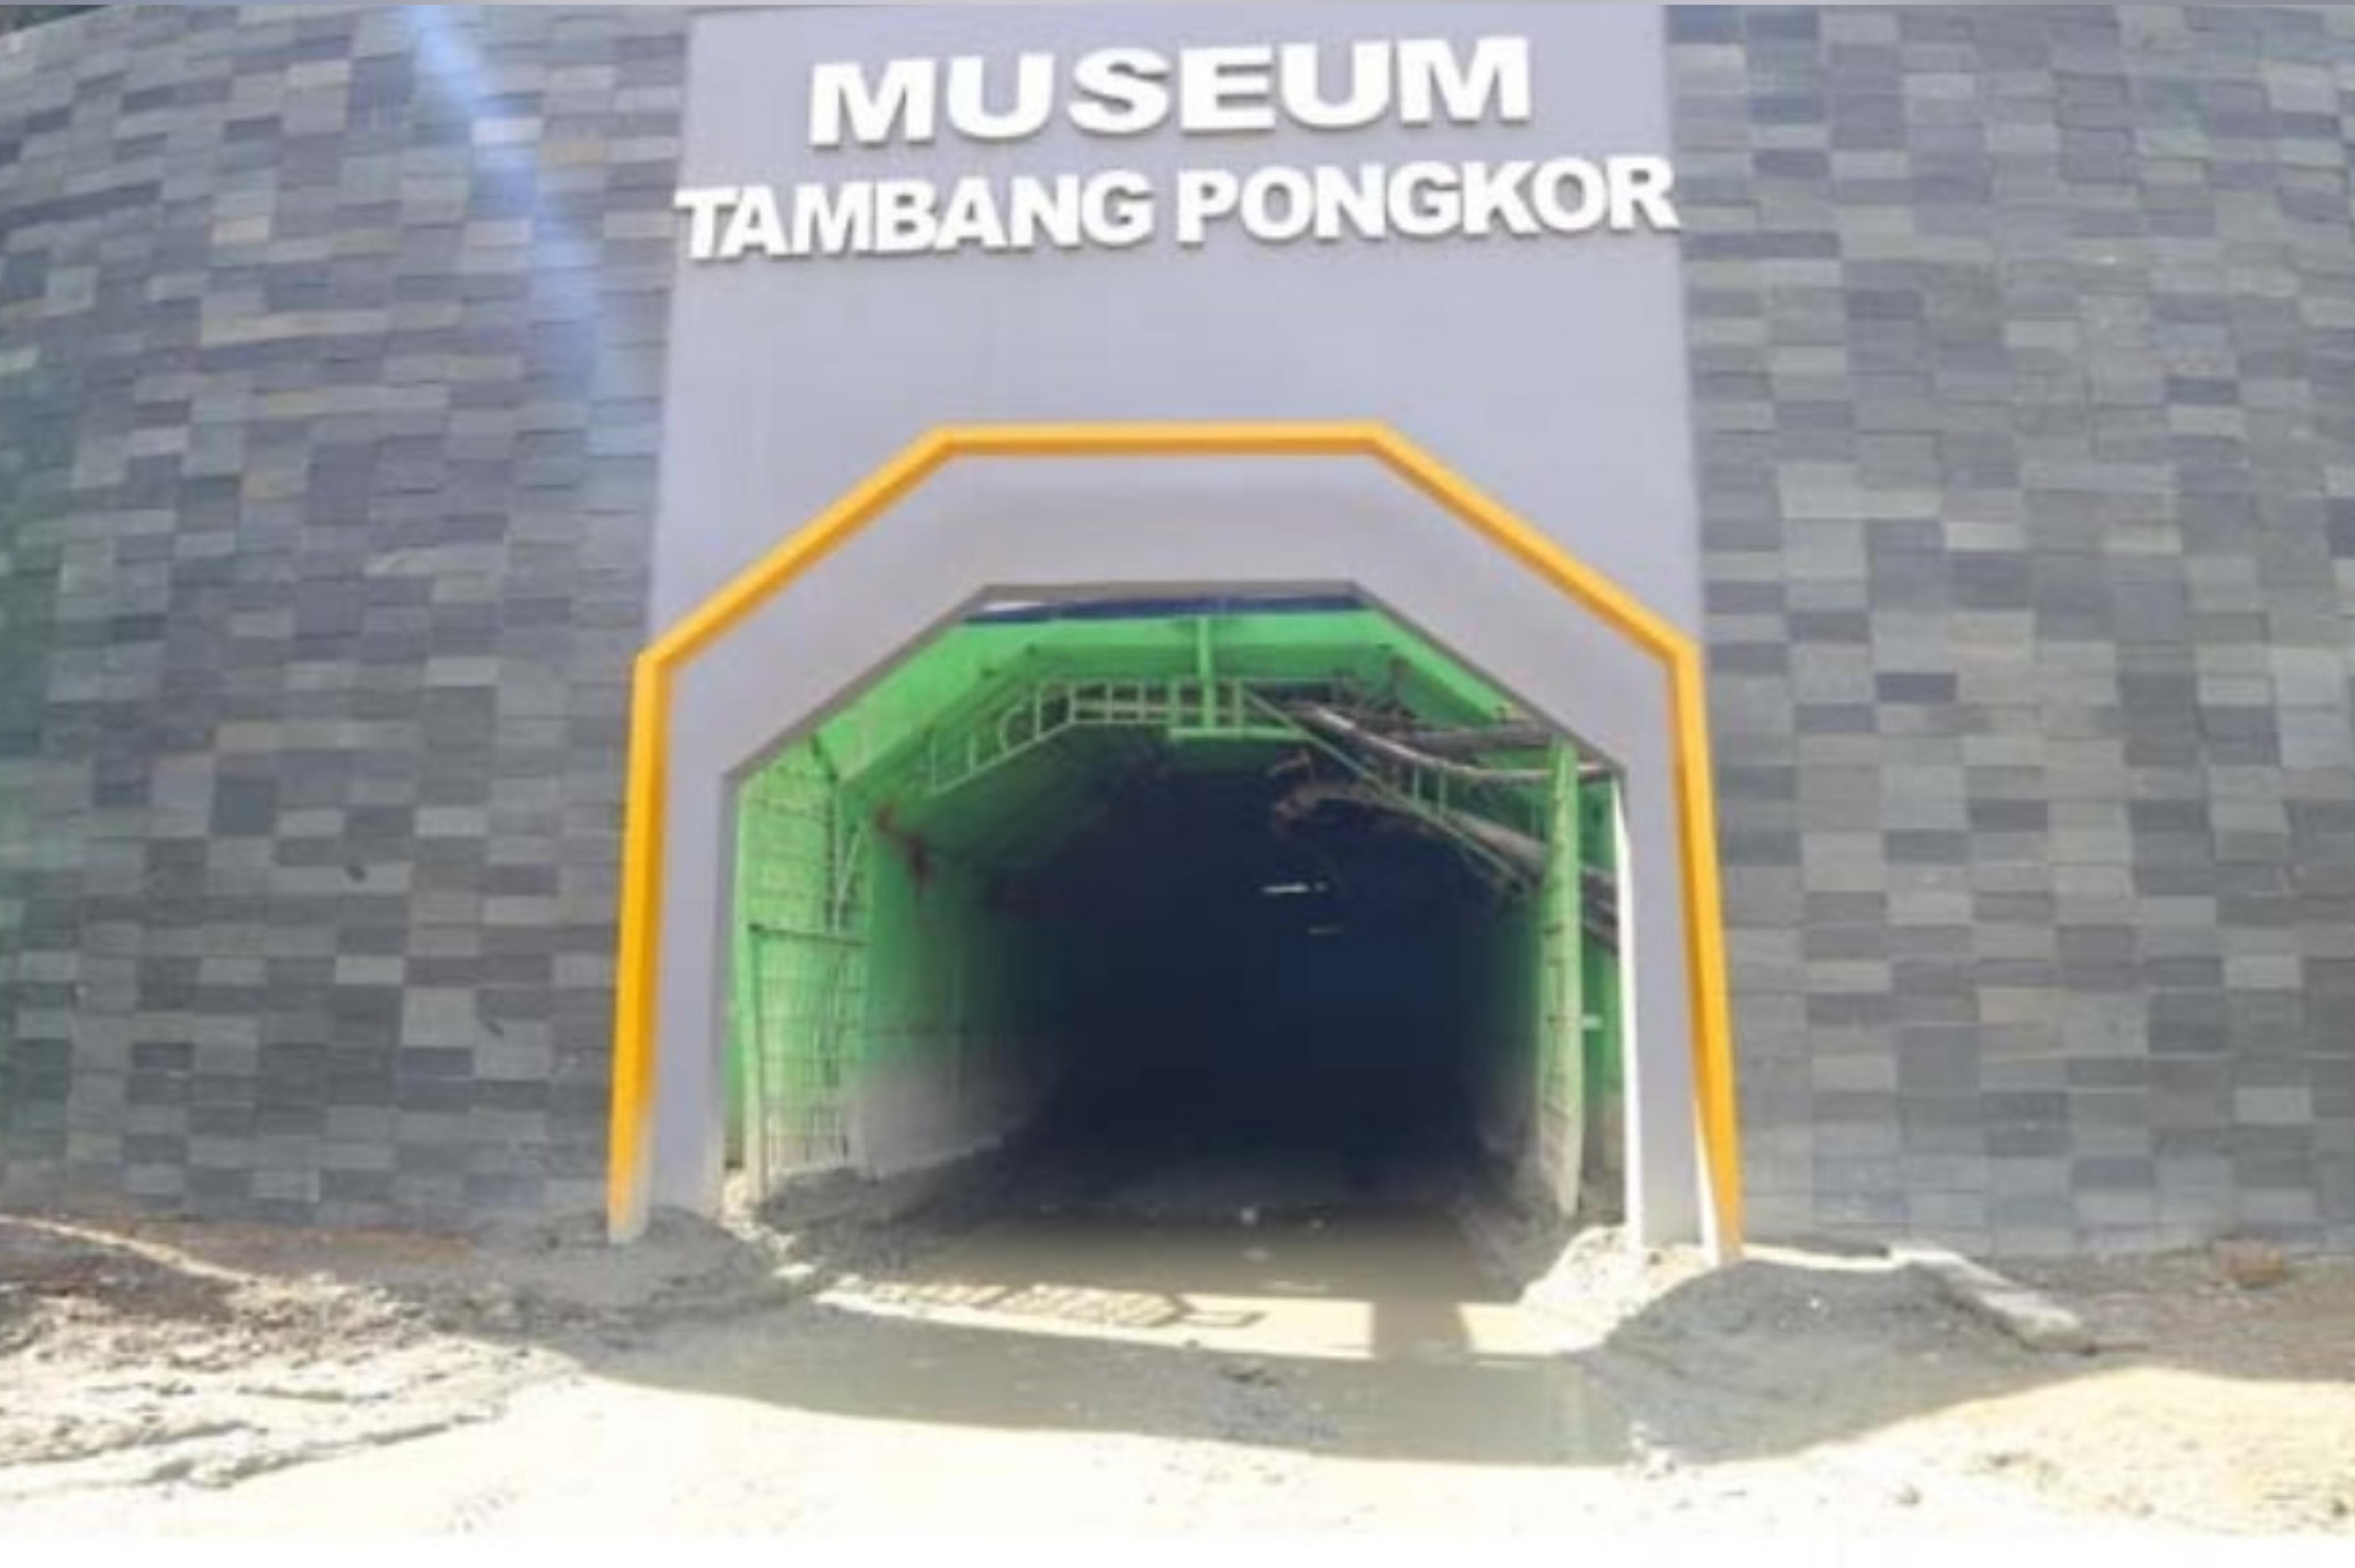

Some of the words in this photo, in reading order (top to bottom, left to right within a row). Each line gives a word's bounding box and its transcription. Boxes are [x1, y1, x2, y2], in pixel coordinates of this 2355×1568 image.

[808, 35, 1531, 146] MUSEUM
[674, 168, 1155, 261] TAMBANG
[1175, 154, 1679, 243] PONGKOR
